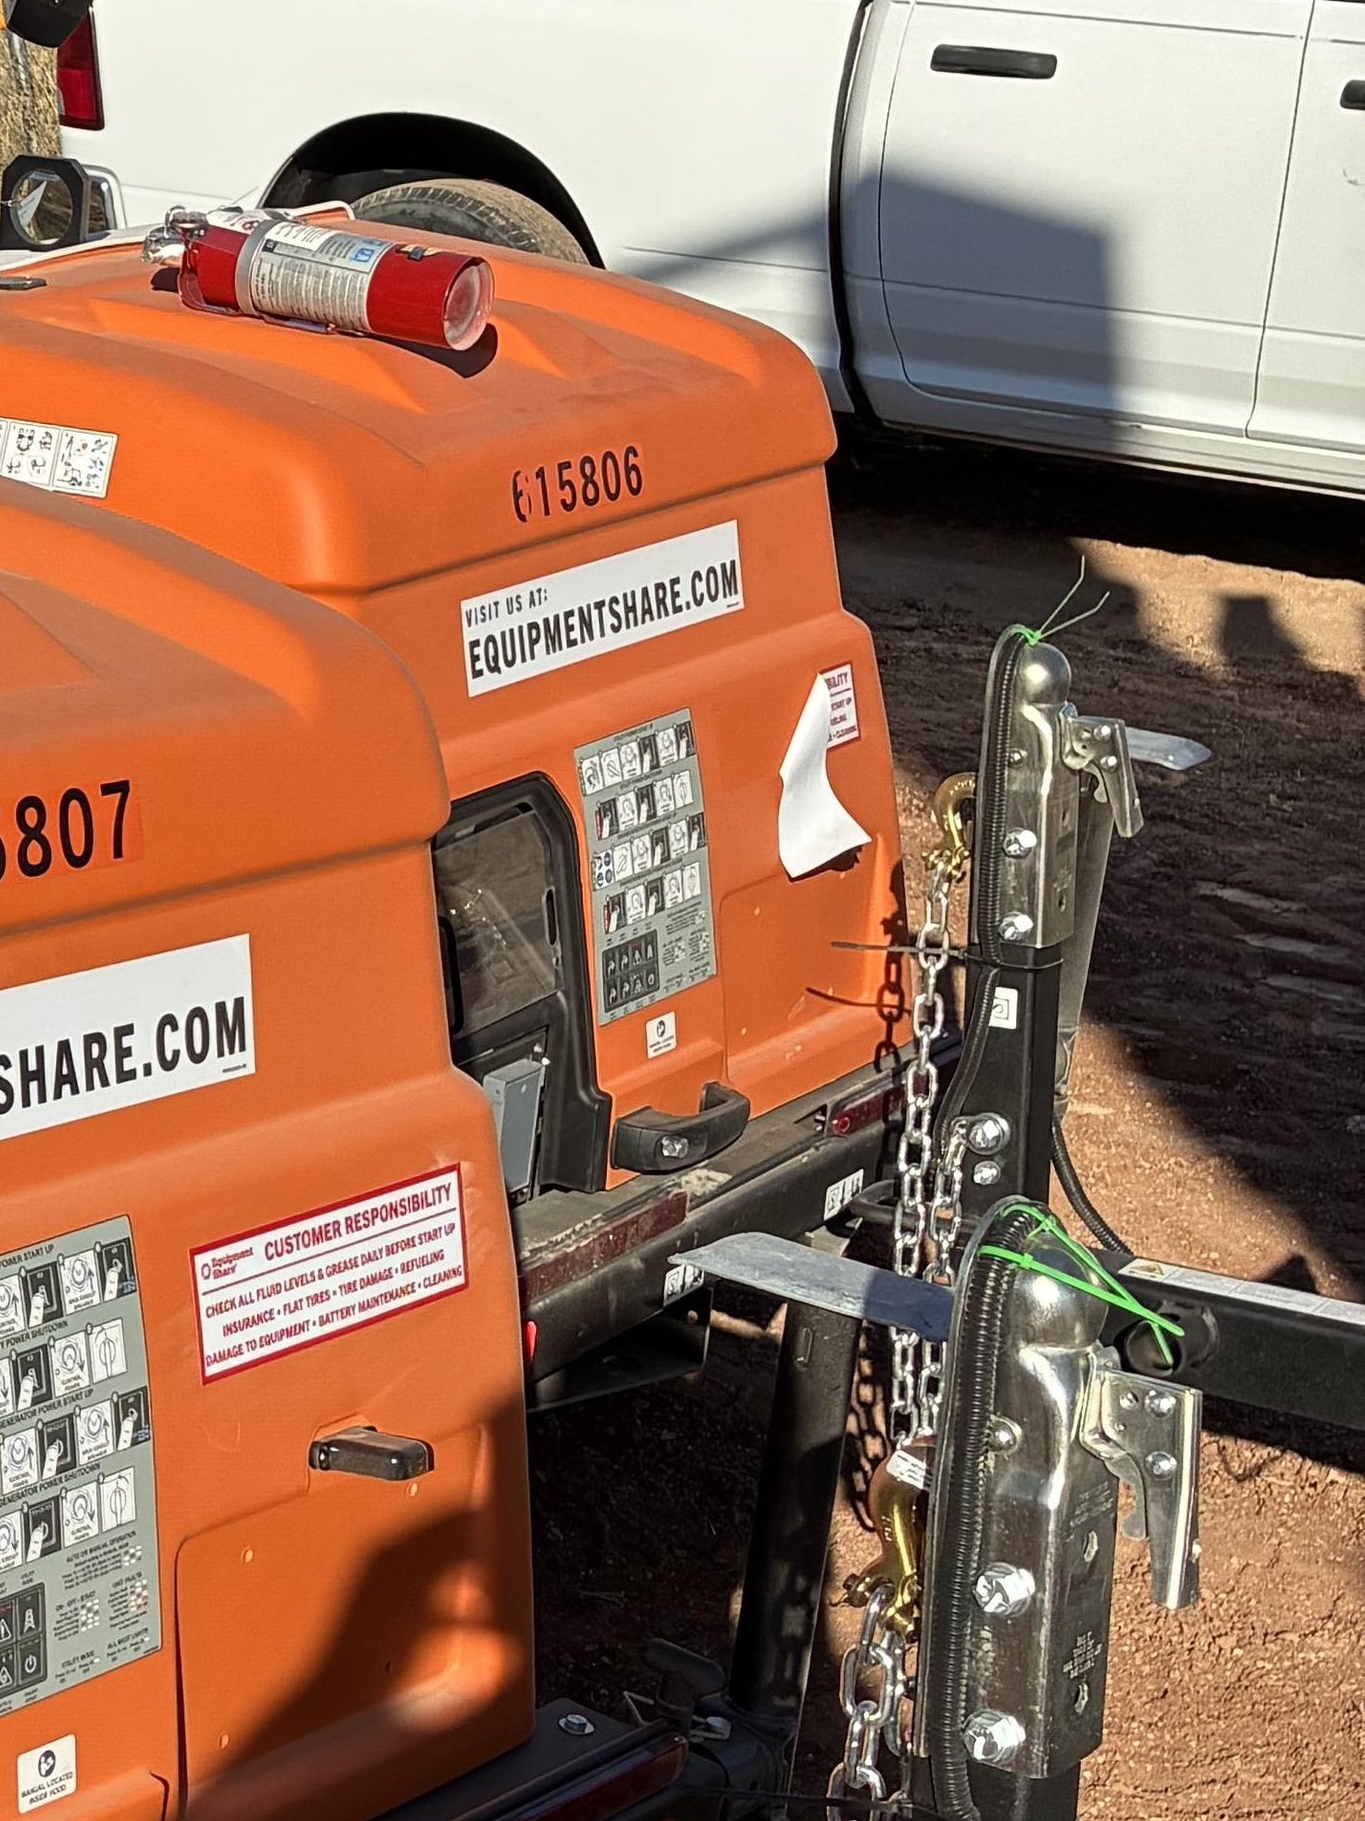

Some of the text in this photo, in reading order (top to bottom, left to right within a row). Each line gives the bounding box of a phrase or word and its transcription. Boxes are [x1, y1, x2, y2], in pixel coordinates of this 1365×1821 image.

[465, 587, 548, 628] VISIT US AT:
[469, 559, 739, 680] EQUIPMENTSHARE.COM
[264, 1183, 452, 1261] CUSTOMER RESPONSIBILITY
[206, 1299, 237, 1319] CHECK
[238, 1291, 255, 1308] ALL
[256, 1282, 282, 1302] FLUID
[283, 1271, 316, 1294] LEVELS
[326, 1256, 359, 1278] GREASE
[360, 1247, 384, 1265] DAILY
[385, 1236, 417, 1256] BEFORE
[417, 1226, 443, 1247] START
[444, 1223, 456, 1235] UP
[206, 1265, 463, 1367] DAMAGE TO EQUIPMENT BATTERY MAINTENANCE CLEANING
[222, 1308, 275, 1337] INSURANCE
[282, 1300, 303, 1316] FLAT
[338, 1280, 358, 1297] TIRE
[359, 1267, 394, 1289] DAMAGE
[400, 1249, 445, 1275] REFUELING
